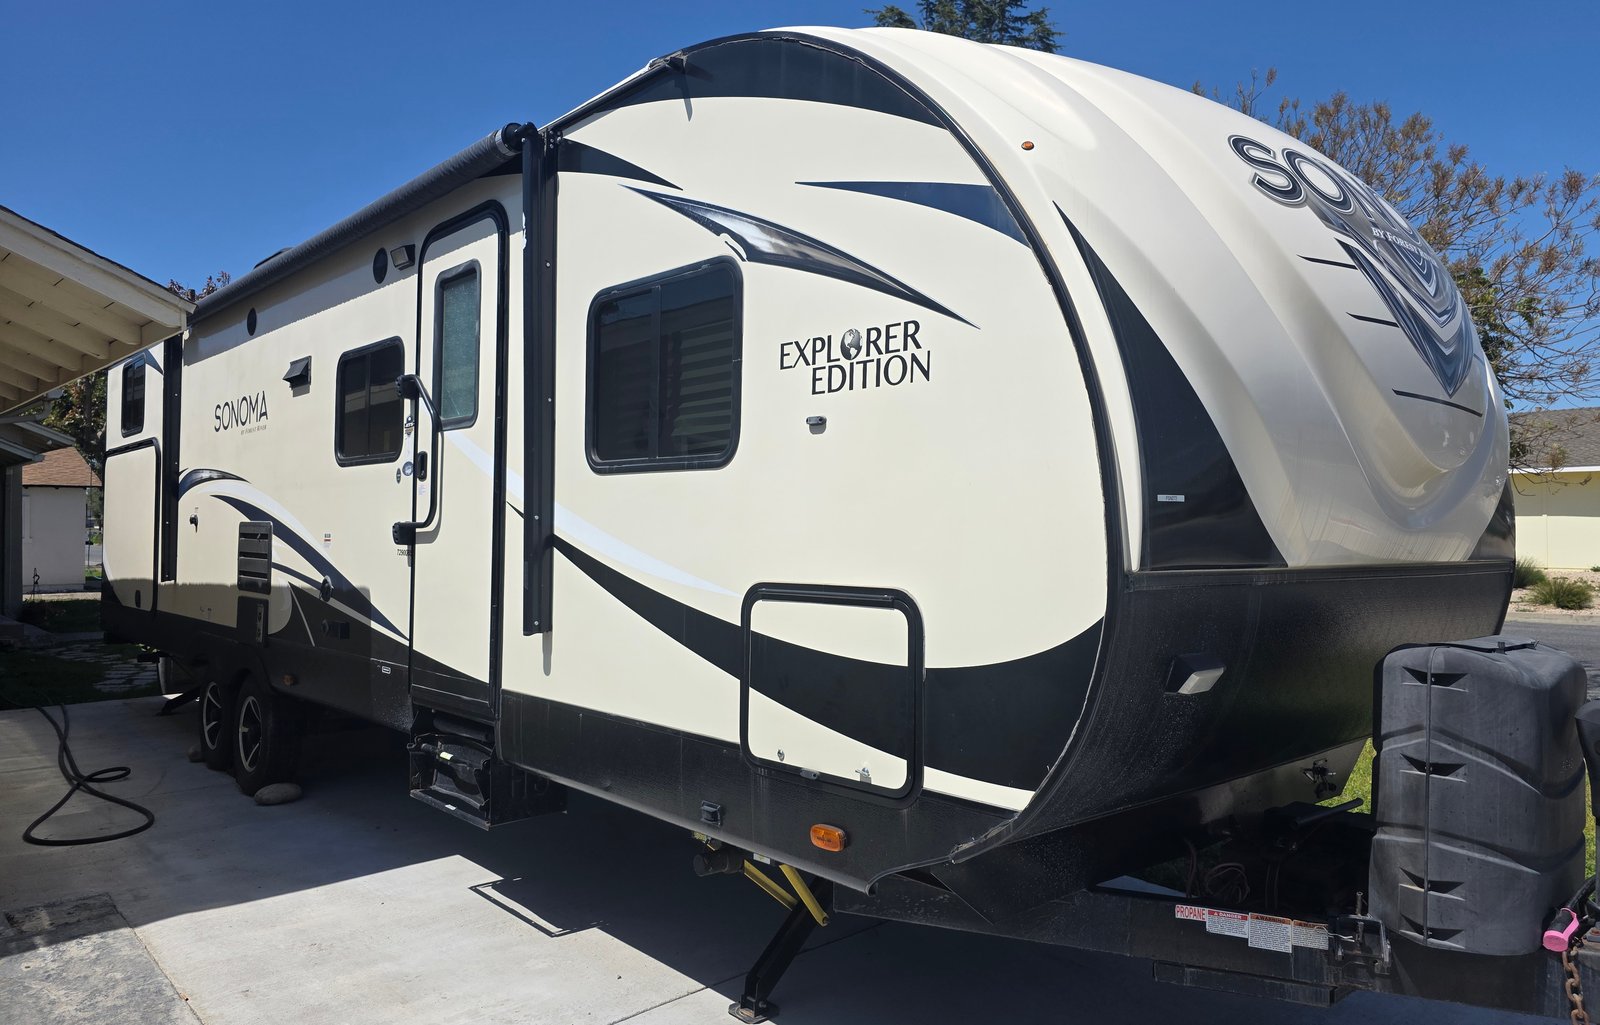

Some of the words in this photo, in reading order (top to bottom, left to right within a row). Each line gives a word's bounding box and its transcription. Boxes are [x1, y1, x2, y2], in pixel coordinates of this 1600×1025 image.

[1371, 226, 1385, 240] BY
[1386, 230, 1420, 255] FOREST
[780, 320, 922, 370] EXPLORER
[812, 350, 931, 395] EDITION
[214, 390, 268, 432] SONOMA
[1176, 905, 1206, 921] PROPANE
